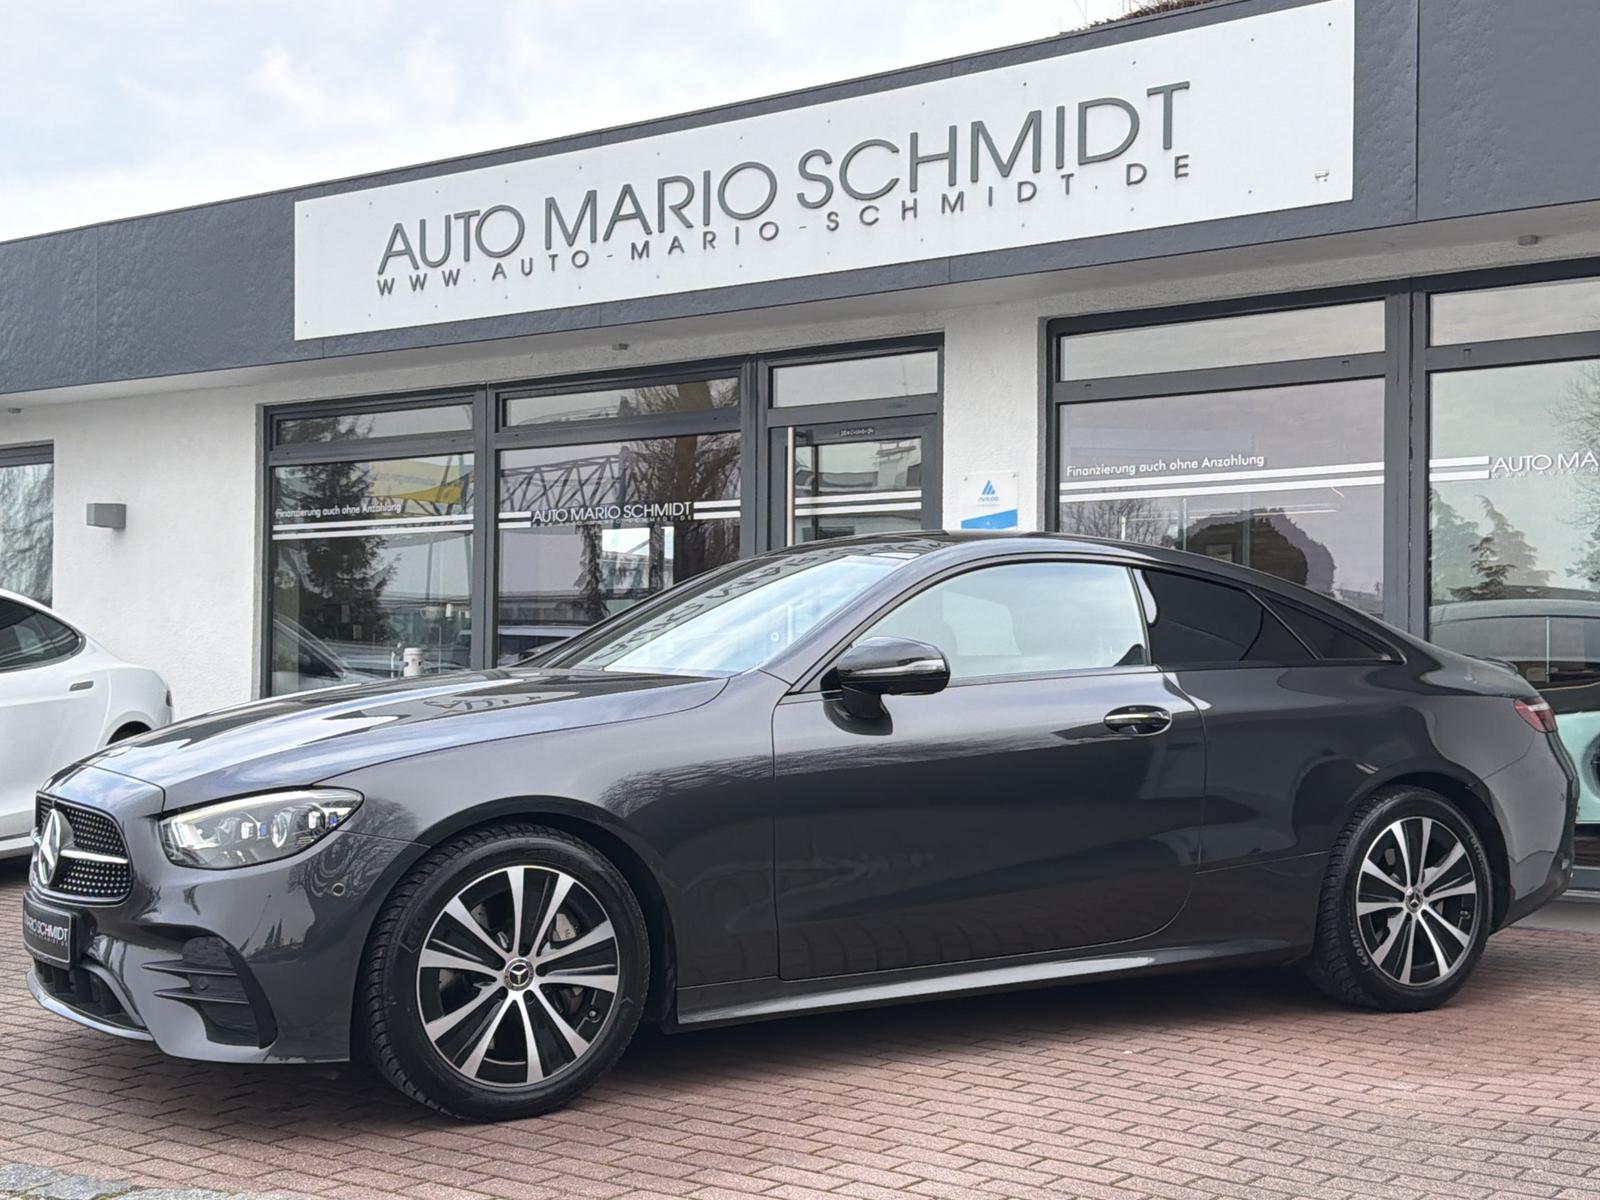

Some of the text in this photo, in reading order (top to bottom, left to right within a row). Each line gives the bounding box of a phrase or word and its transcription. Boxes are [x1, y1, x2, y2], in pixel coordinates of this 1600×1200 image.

[378, 81, 1191, 275] AUTO MARIO SCHMIDT
[1066, 454, 1265, 477] Finanzierung auch ohne Anzahlung
[1491, 454, 1552, 472] AUTO
[322, 505, 340, 516] auch
[342, 504, 361, 515] ohne
[532, 501, 692, 523] AUTO MARIO SCHMIDT
